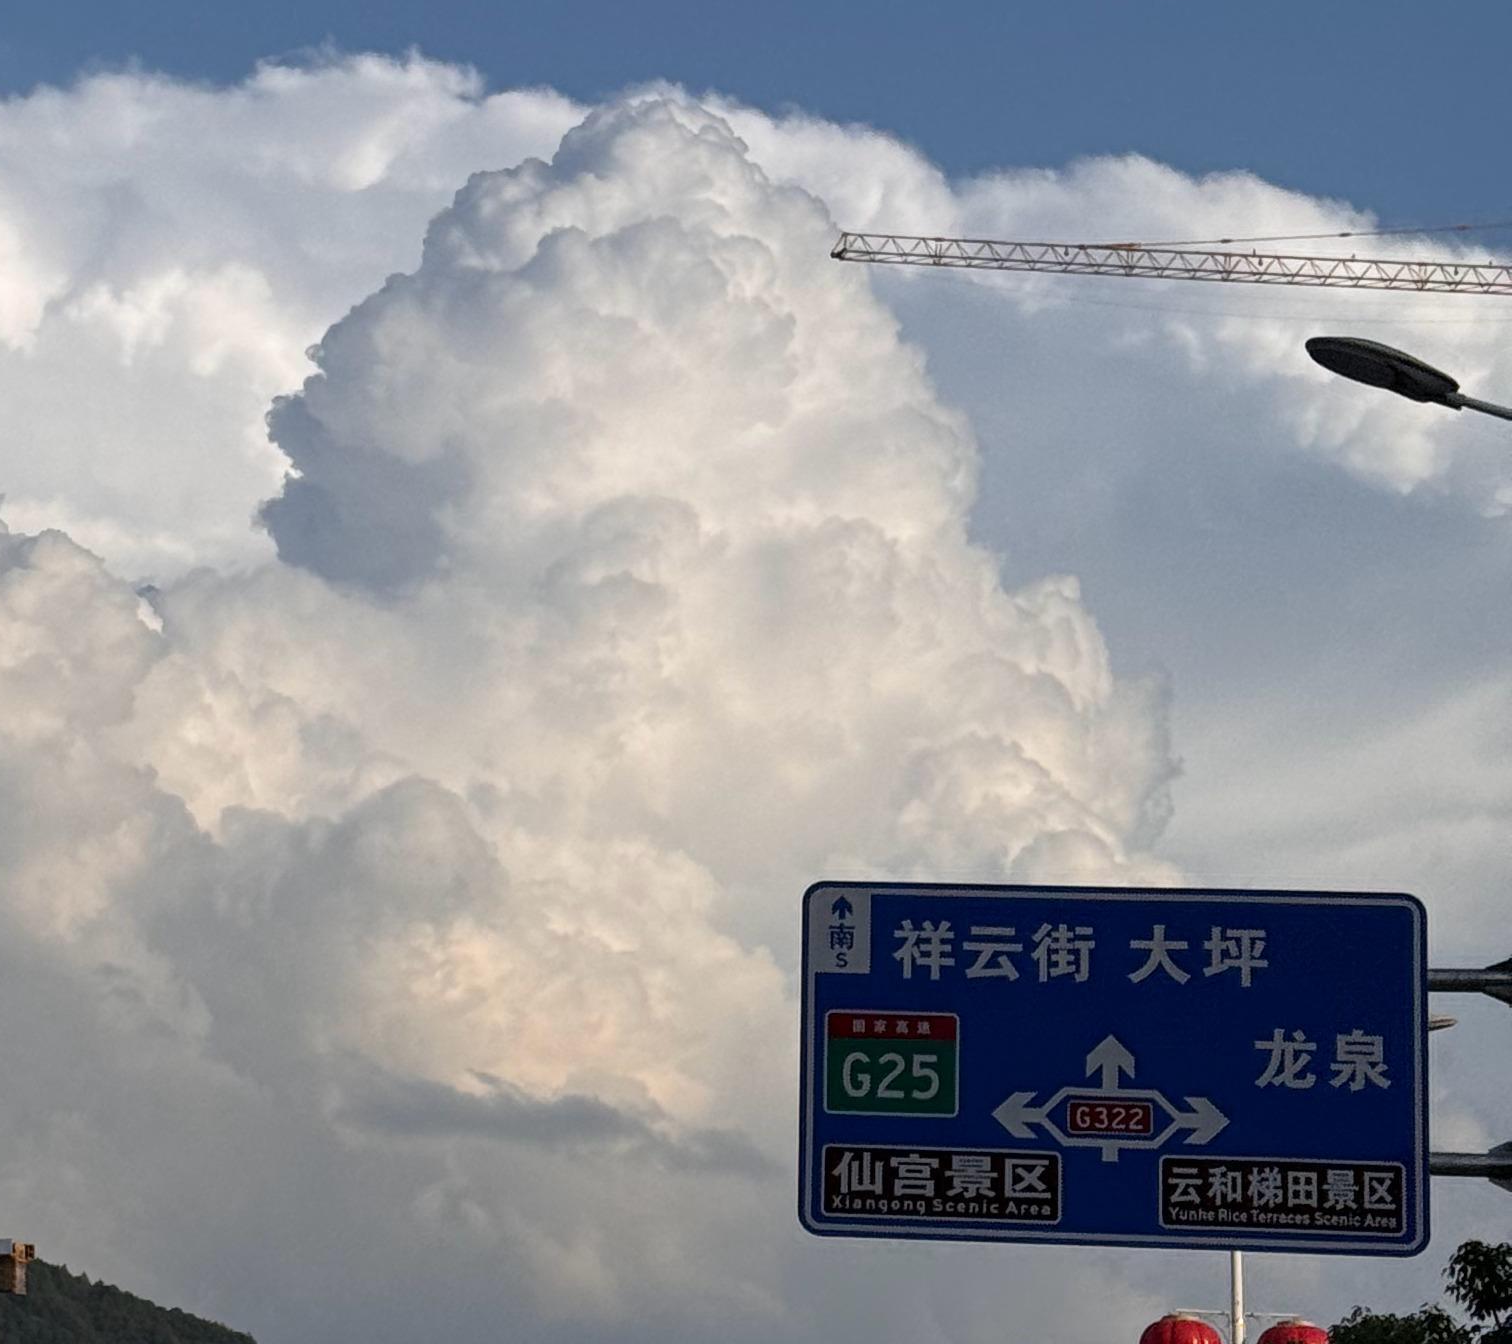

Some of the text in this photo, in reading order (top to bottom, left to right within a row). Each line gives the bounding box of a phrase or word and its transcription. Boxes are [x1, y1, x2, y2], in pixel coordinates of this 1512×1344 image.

[829, 923, 855, 951] 南
[893, 919, 1269, 987] 祥云街 大坪
[835, 952, 849, 968] S
[842, 1051, 940, 1100] G25
[1254, 1028, 1392, 1093] 龙泉
[1076, 1106, 1144, 1130] G322
[831, 1151, 1052, 1199] 仙宫景区
[1167, 1165, 1397, 1211] 云和梯田景区
[831, 1194, 1052, 1216] Xiangong Scenic Area
[1218, 1208, 1248, 1223] Rice
[1314, 1211, 1362, 1227] Scenic
[1364, 1213, 1398, 1229] Area
